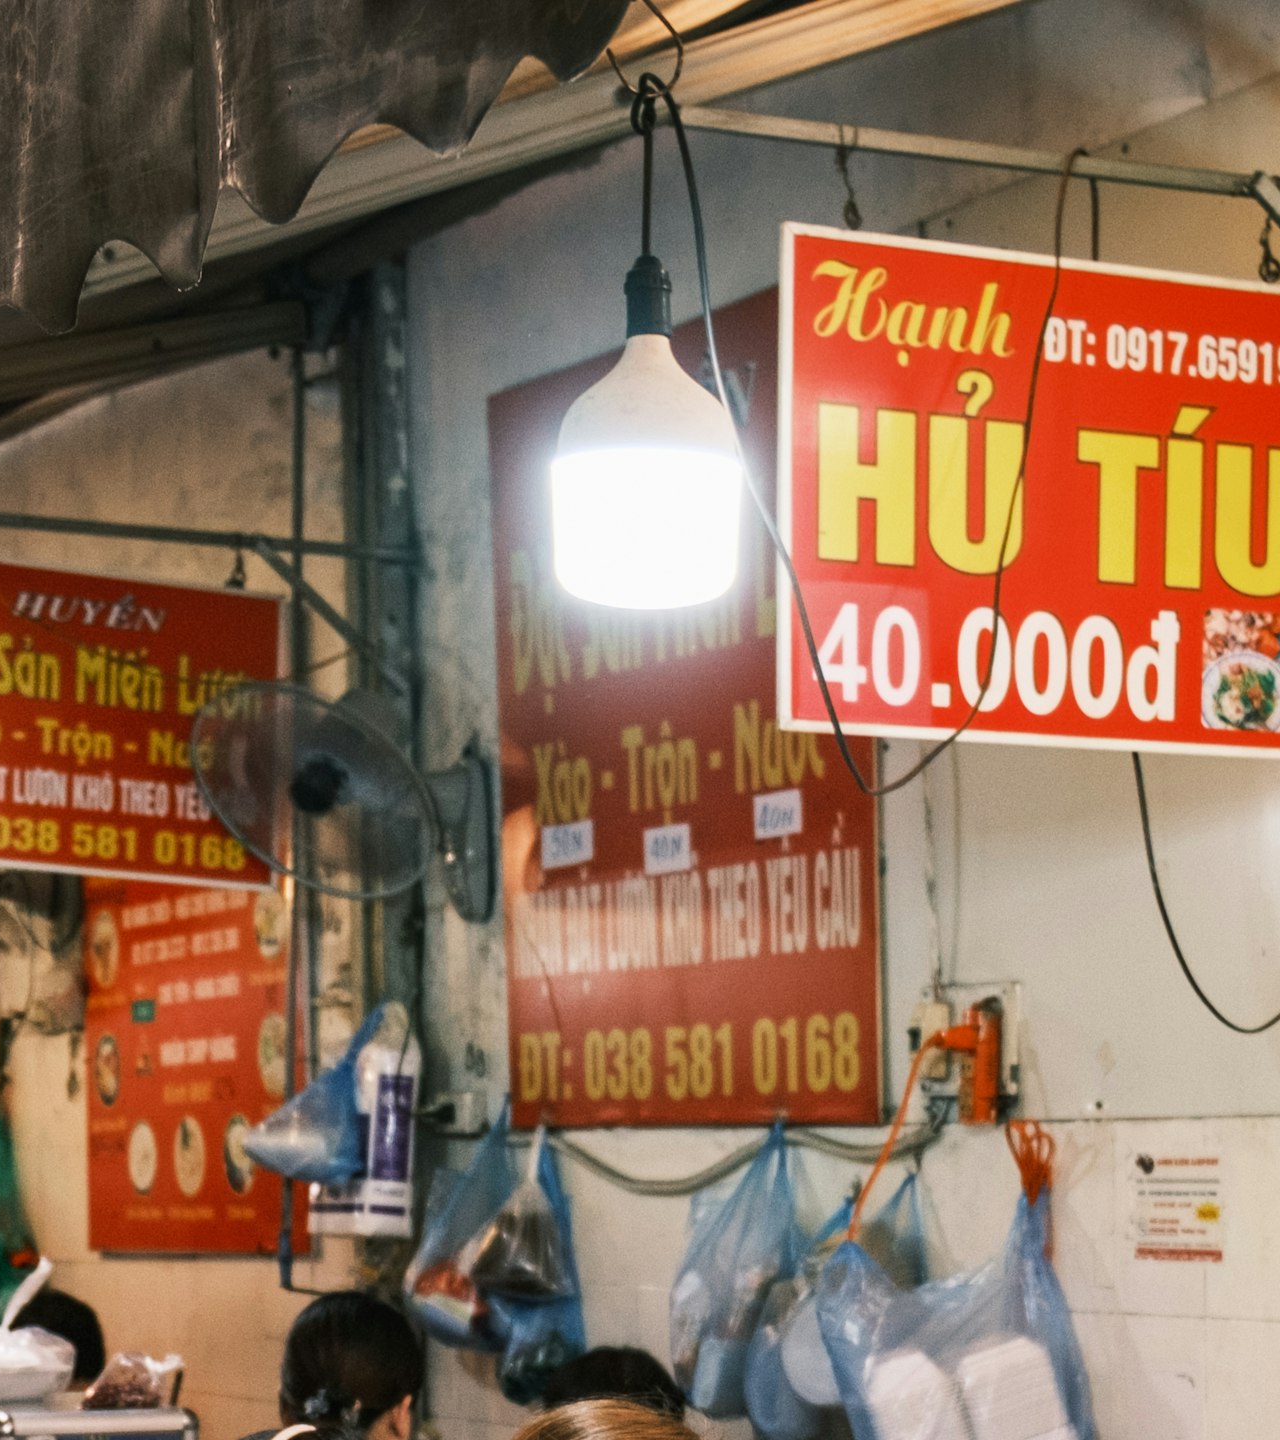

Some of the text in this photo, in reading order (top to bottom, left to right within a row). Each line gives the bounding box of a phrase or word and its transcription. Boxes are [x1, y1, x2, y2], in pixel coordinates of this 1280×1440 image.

[811, 259, 1014, 367] Hạnh
[1043, 316, 1097, 367] ĐT:
[817, 369, 1025, 576] HỦ
[812, 602, 1181, 723] 40.000đ
[36, 717, 113, 767] Trộn
[532, 738, 594, 826] Xào
[622, 721, 698, 827] Trộn
[72, 822, 138, 863] 581
[154, 830, 246, 872] 0168
[120, 778, 169, 818] THEO
[707, 861, 761, 963] THEO
[519, 1012, 861, 1102] ĐT: 038 581 0168
